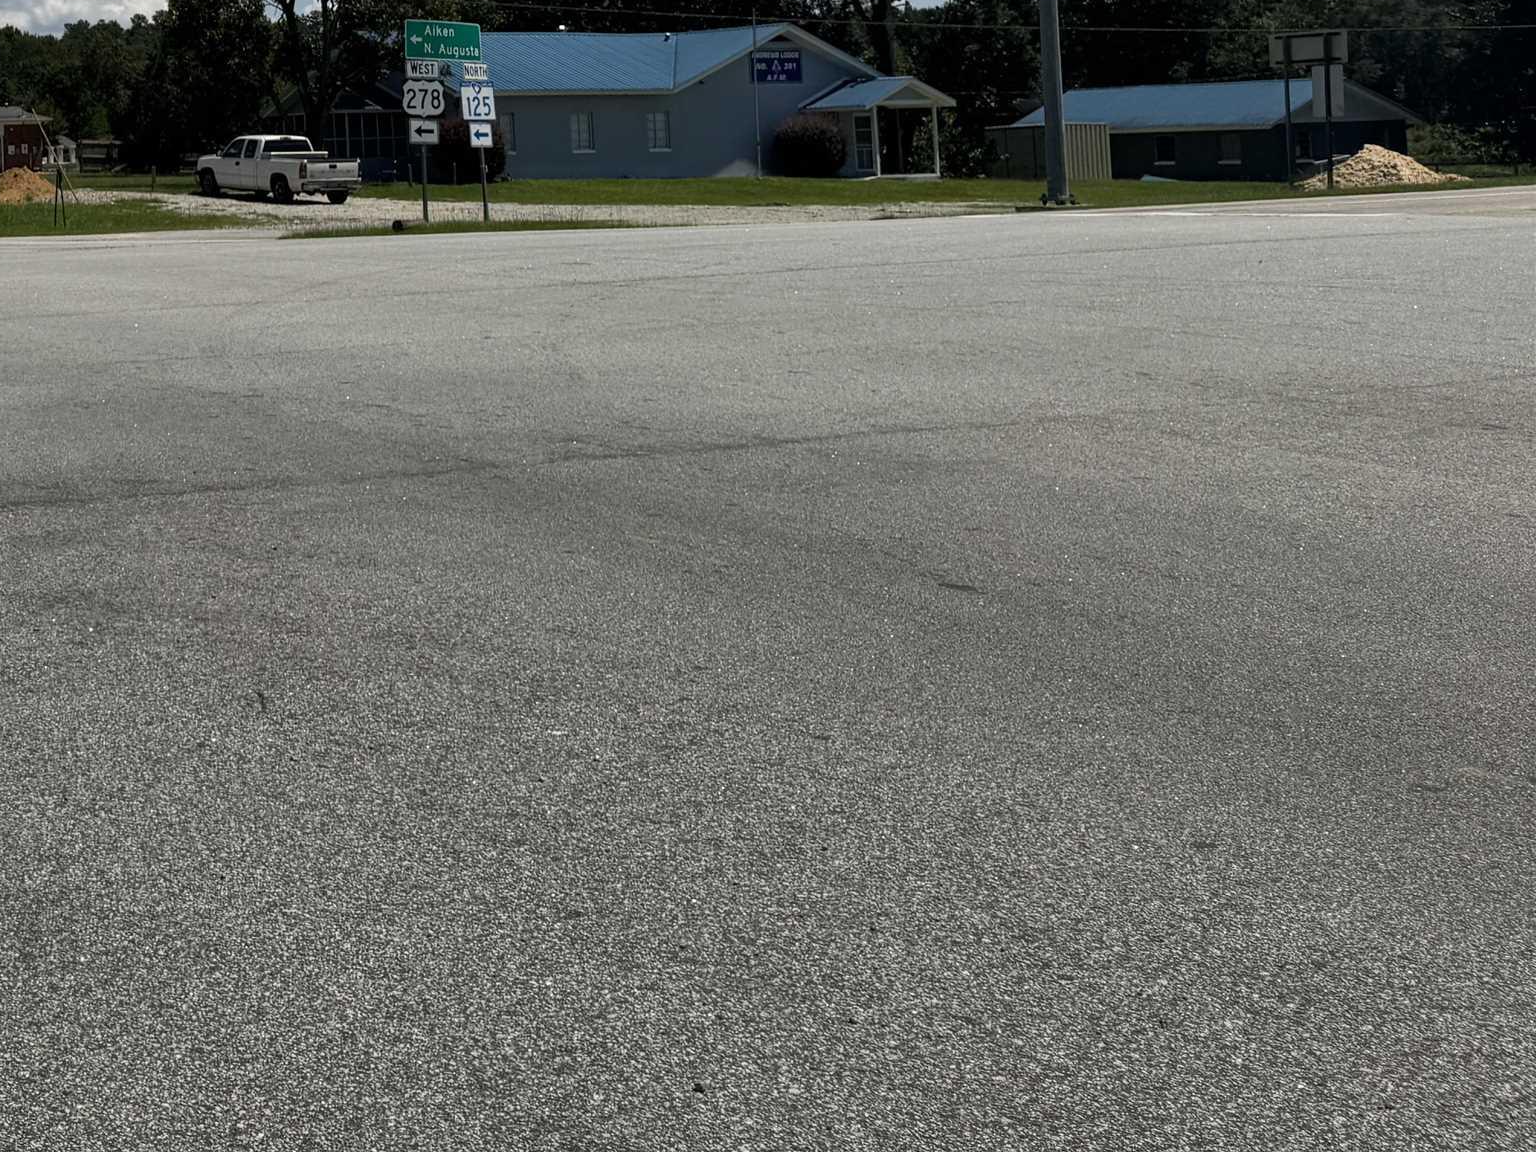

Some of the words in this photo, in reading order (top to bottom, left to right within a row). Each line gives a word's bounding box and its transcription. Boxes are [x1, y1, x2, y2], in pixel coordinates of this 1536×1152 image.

[423, 25, 455, 37] Aiken
[424, 42, 435, 54] N.
[438, 44, 480, 58] Augusta
[410, 62, 435, 74] WEST
[464, 65, 488, 77] NORTH
[406, 89, 441, 109] 278
[467, 96, 491, 116] 125
